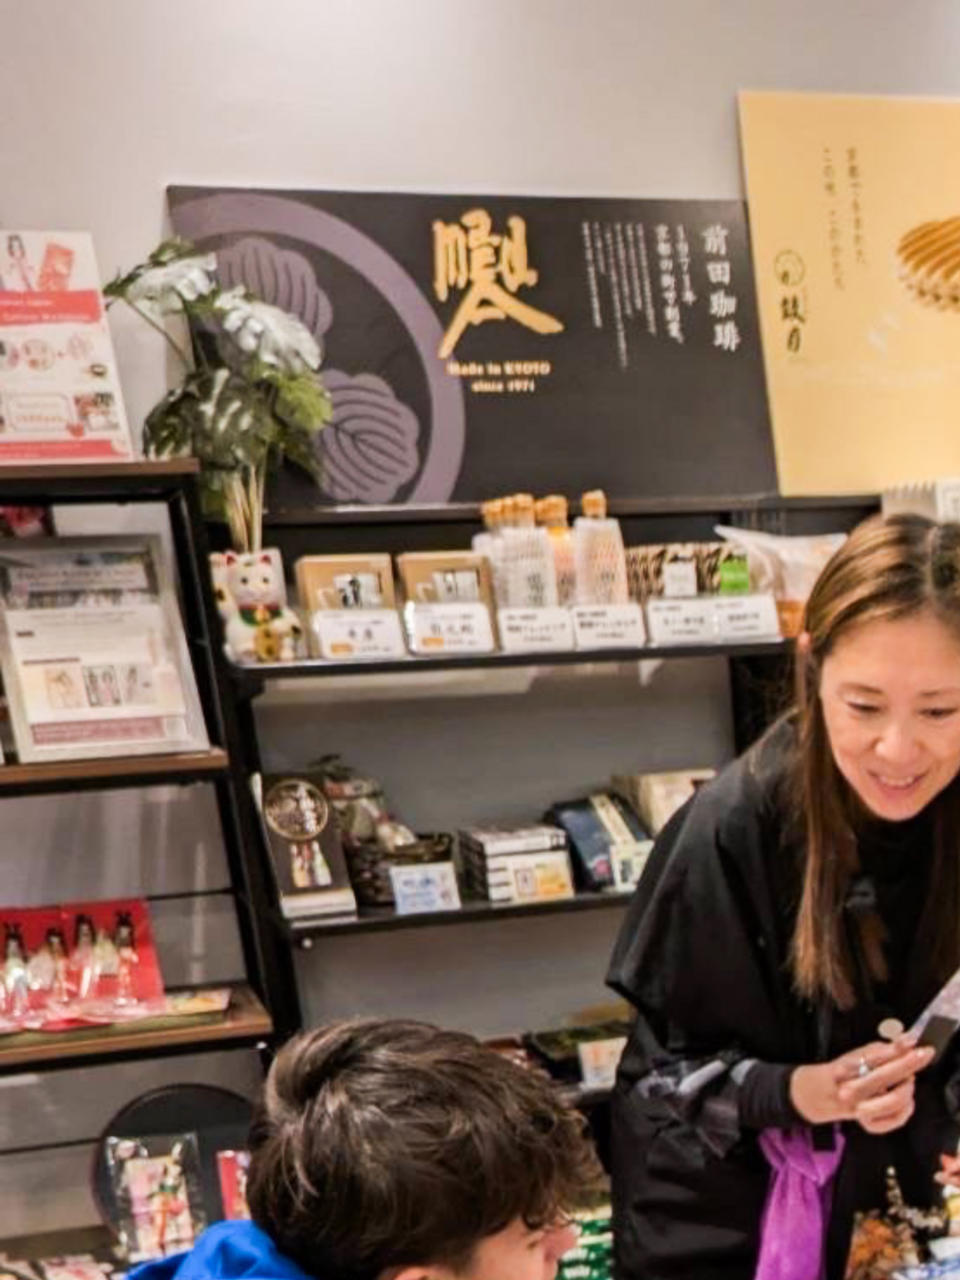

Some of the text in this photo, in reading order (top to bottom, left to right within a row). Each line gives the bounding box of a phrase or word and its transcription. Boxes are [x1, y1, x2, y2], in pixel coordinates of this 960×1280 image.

[701, 223, 742, 353] 前田珈琲
[503, 361, 552, 375] KYOTO
